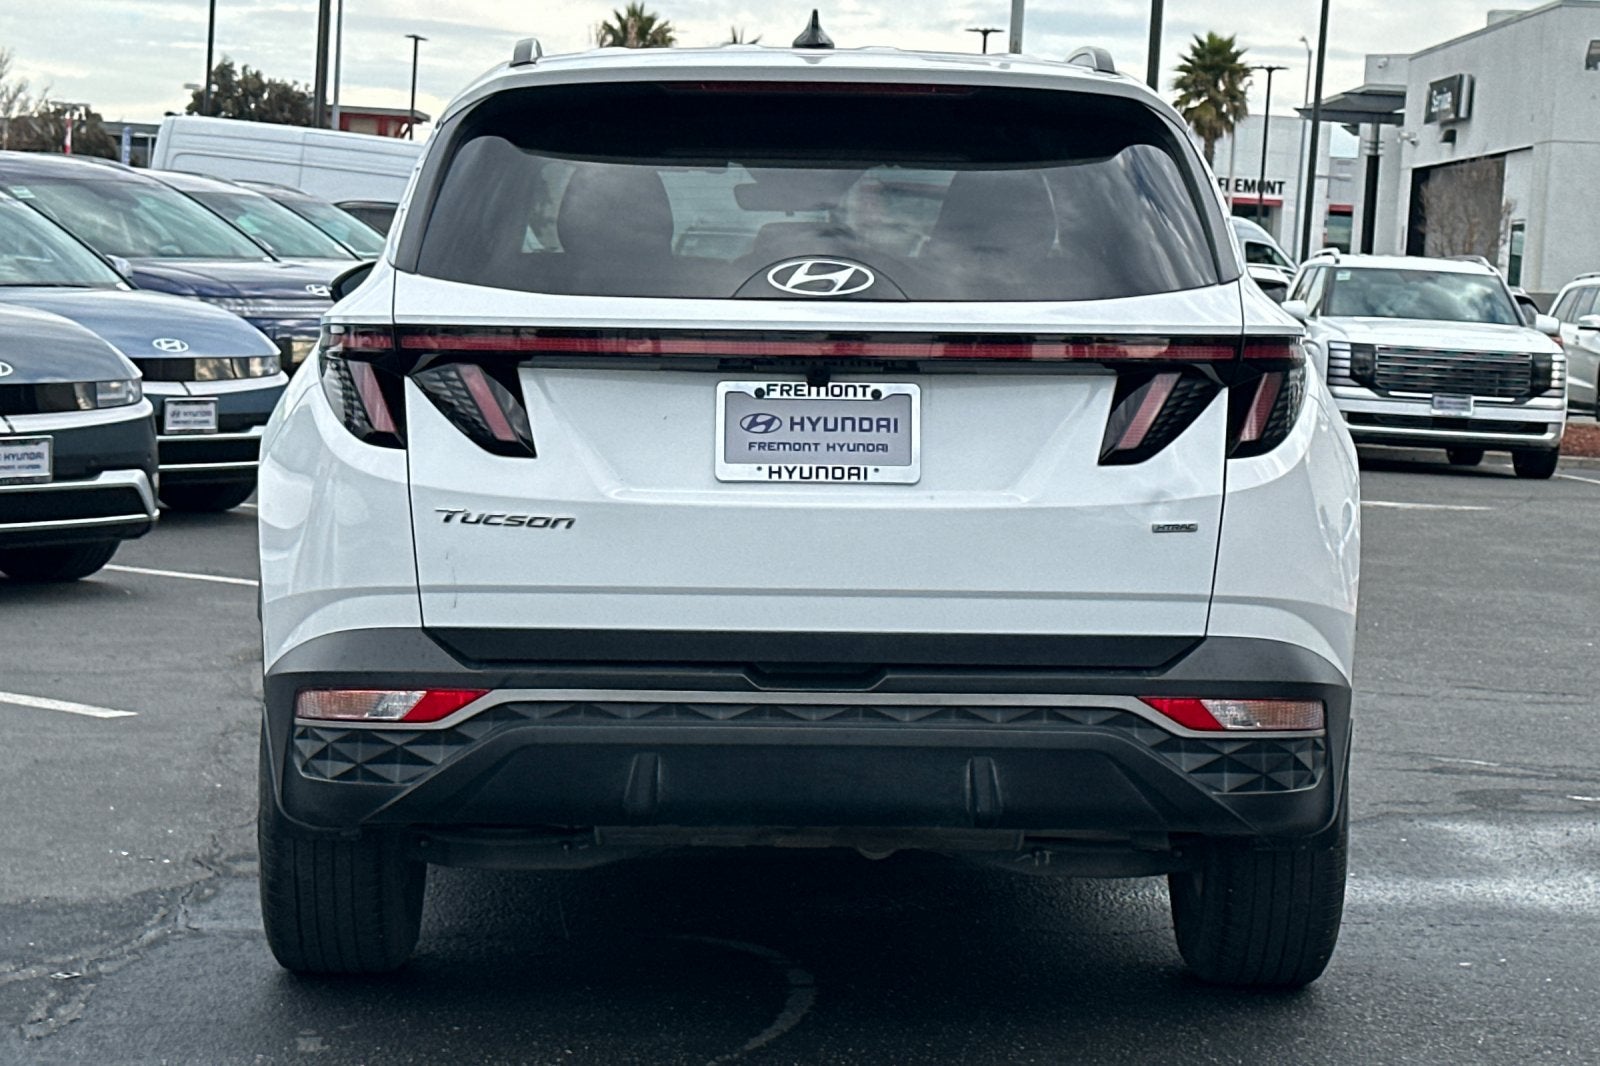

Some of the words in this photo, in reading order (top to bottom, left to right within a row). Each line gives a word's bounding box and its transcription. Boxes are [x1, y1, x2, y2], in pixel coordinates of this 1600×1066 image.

[766, 383, 871, 398] FREMONT
[789, 416, 899, 433] HYUNDAI
[748, 441, 820, 452] FREMONT
[826, 442, 888, 453] HYUNDAI
[768, 465, 868, 481] HYUNDAI
